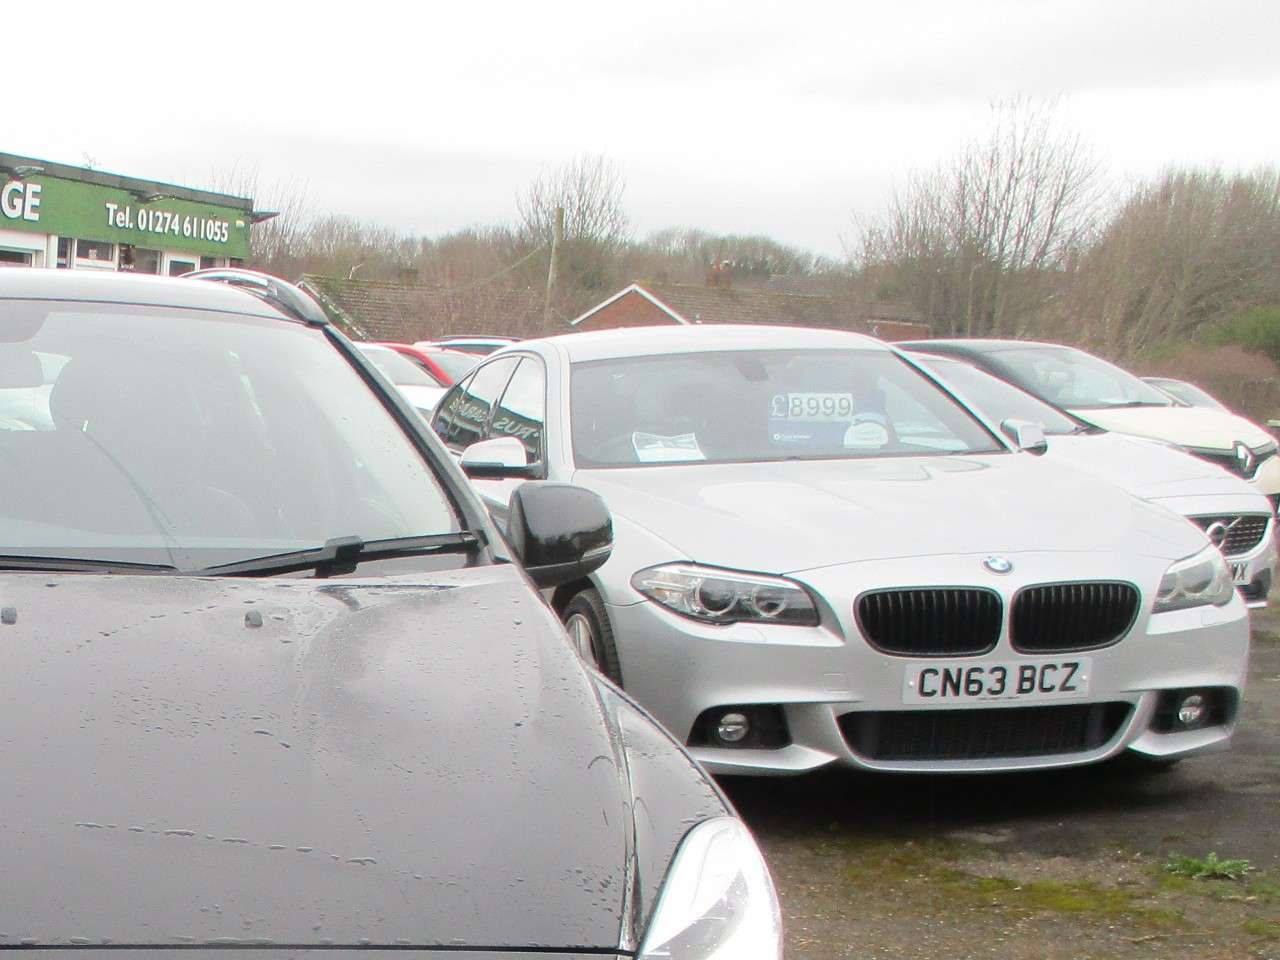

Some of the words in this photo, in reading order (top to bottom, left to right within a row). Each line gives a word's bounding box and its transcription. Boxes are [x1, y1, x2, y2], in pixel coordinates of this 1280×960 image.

[105, 202, 134, 230] Tel.
[137, 207, 180, 237] 01274
[183, 216, 230, 244] 611055
[770, 394, 852, 418] £8999
[918, 666, 1008, 698] CN63
[1016, 662, 1080, 695] BCZ
